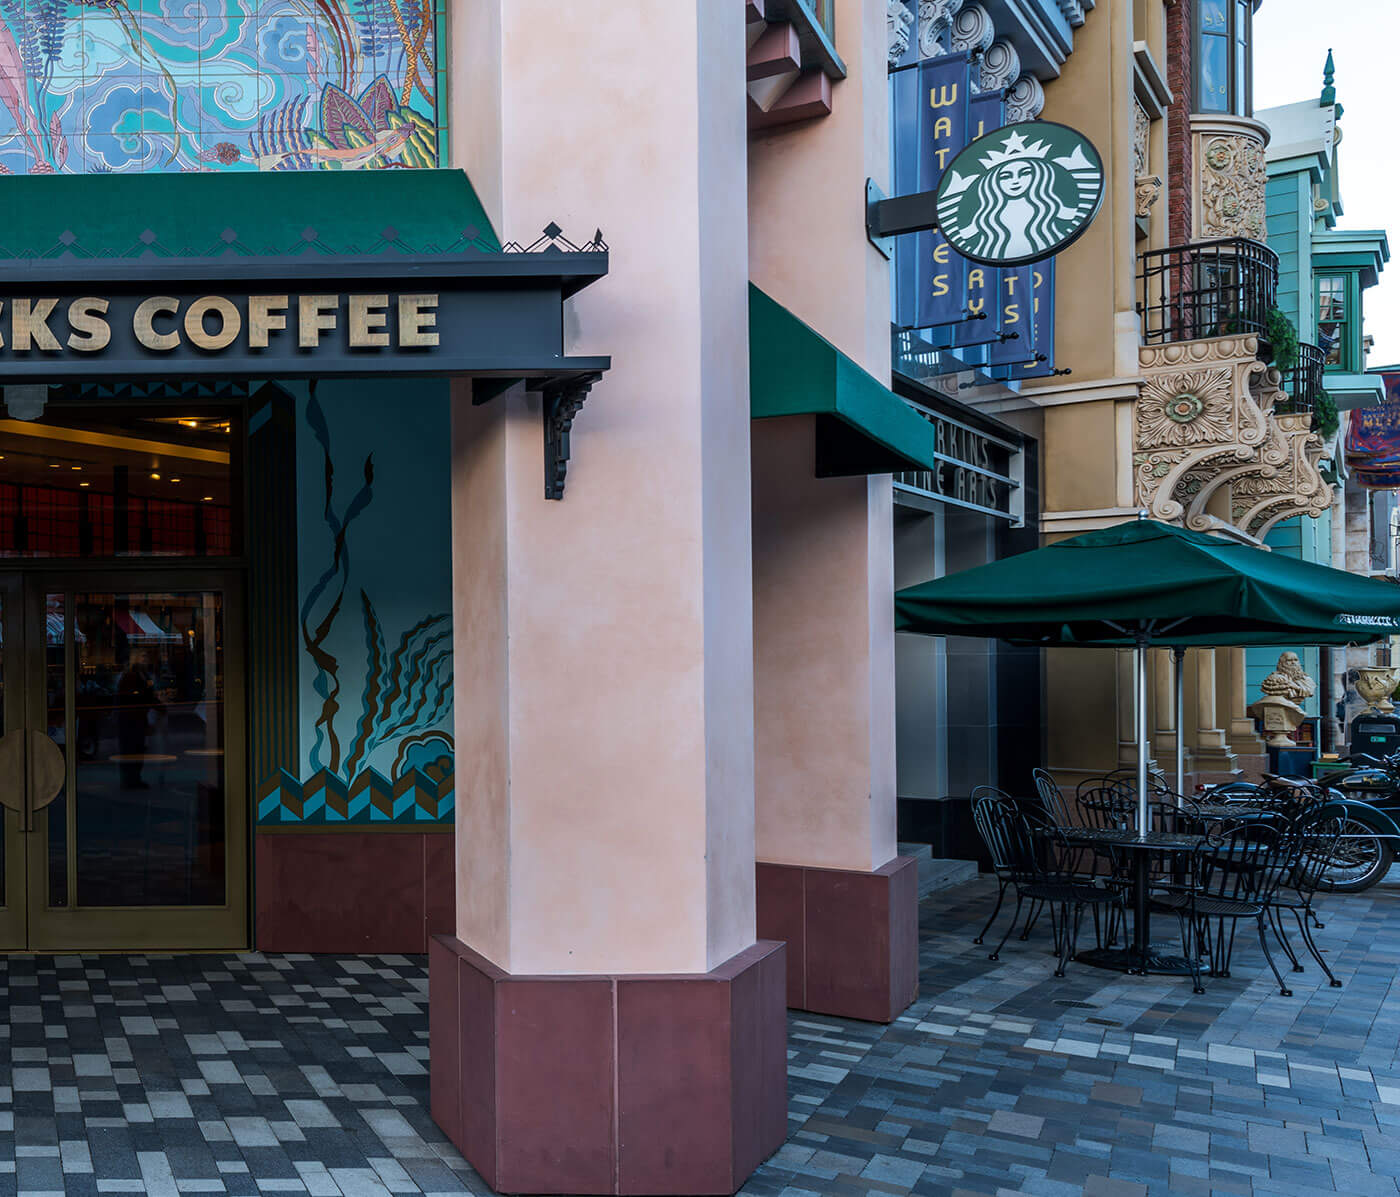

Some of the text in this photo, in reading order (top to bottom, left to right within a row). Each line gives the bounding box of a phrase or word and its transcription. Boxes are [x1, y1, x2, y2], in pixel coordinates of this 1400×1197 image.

[930, 83, 958, 297] WATES
[133, 294, 440, 351] COFFEE
[926, 412, 989, 470] RKINS
[901, 460, 997, 510] NE ARTS
